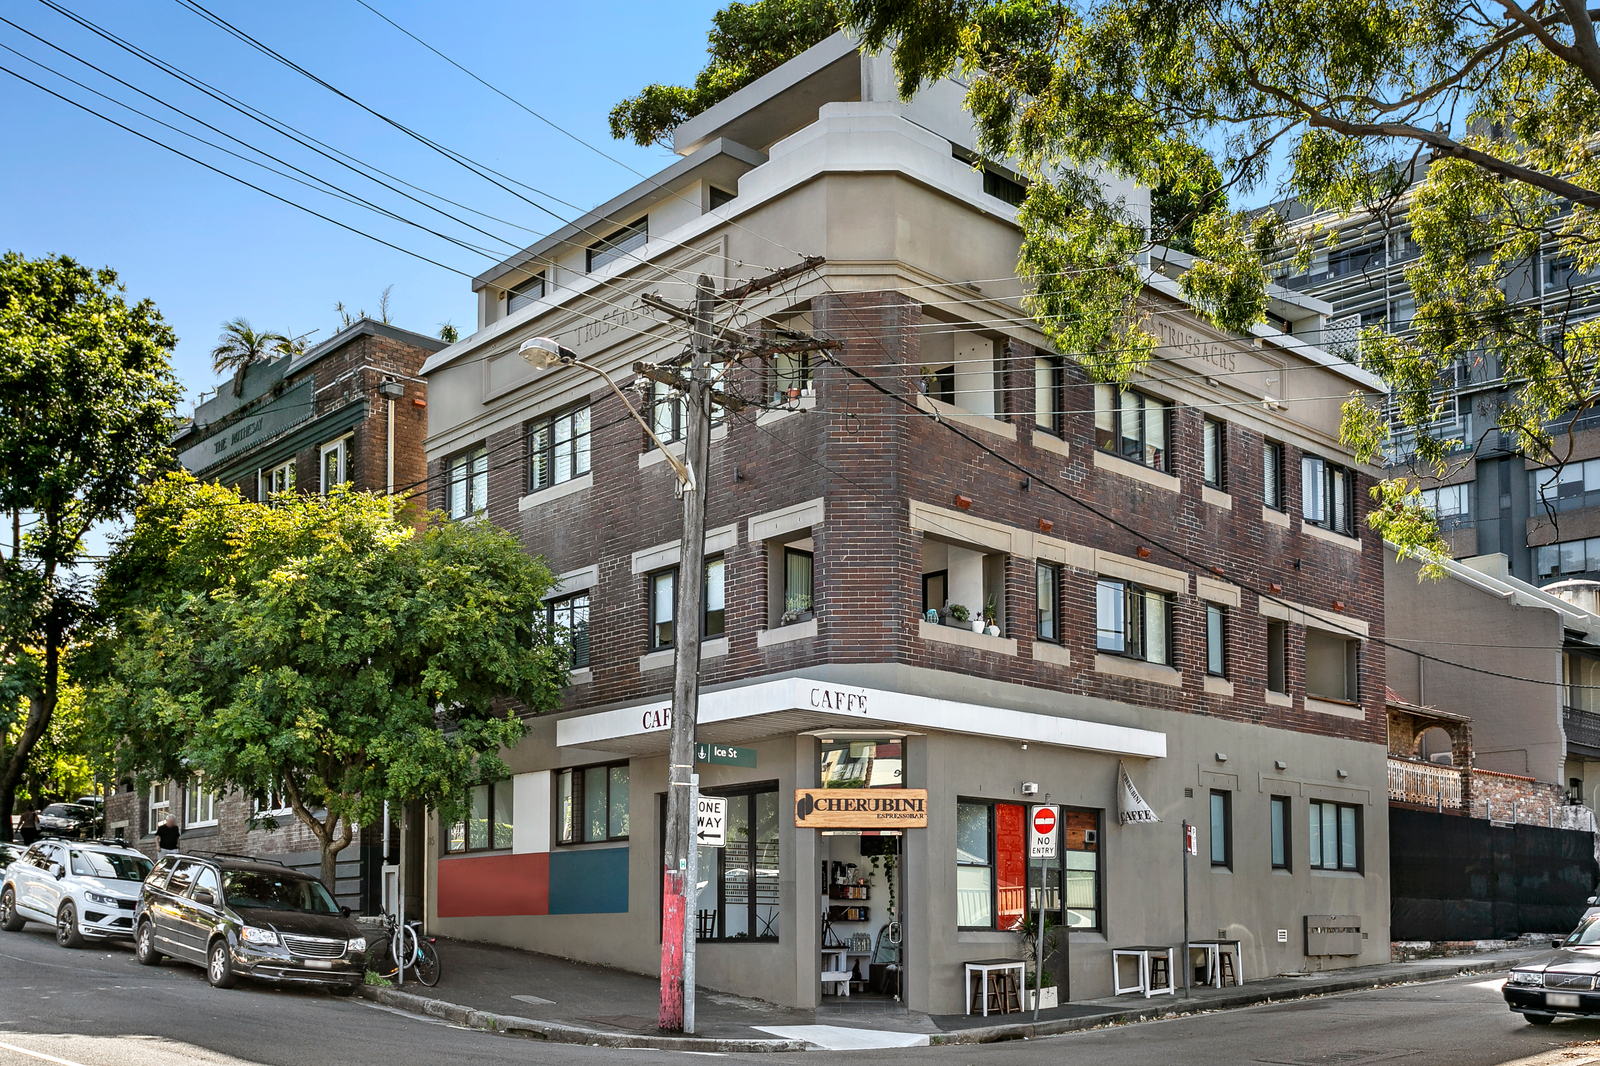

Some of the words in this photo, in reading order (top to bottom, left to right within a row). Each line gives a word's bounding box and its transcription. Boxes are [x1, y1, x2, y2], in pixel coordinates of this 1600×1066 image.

[574, 298, 652, 347] TROSSAC
[1158, 321, 1236, 372] TROSSACHS
[214, 438, 227, 454] THE
[714, 746, 727, 757] Ice
[728, 747, 738, 758] St
[698, 801, 721, 813] ONE
[813, 798, 925, 812] CHERUBINI
[697, 816, 722, 828] WAY
[1037, 837, 1050, 845] NO
